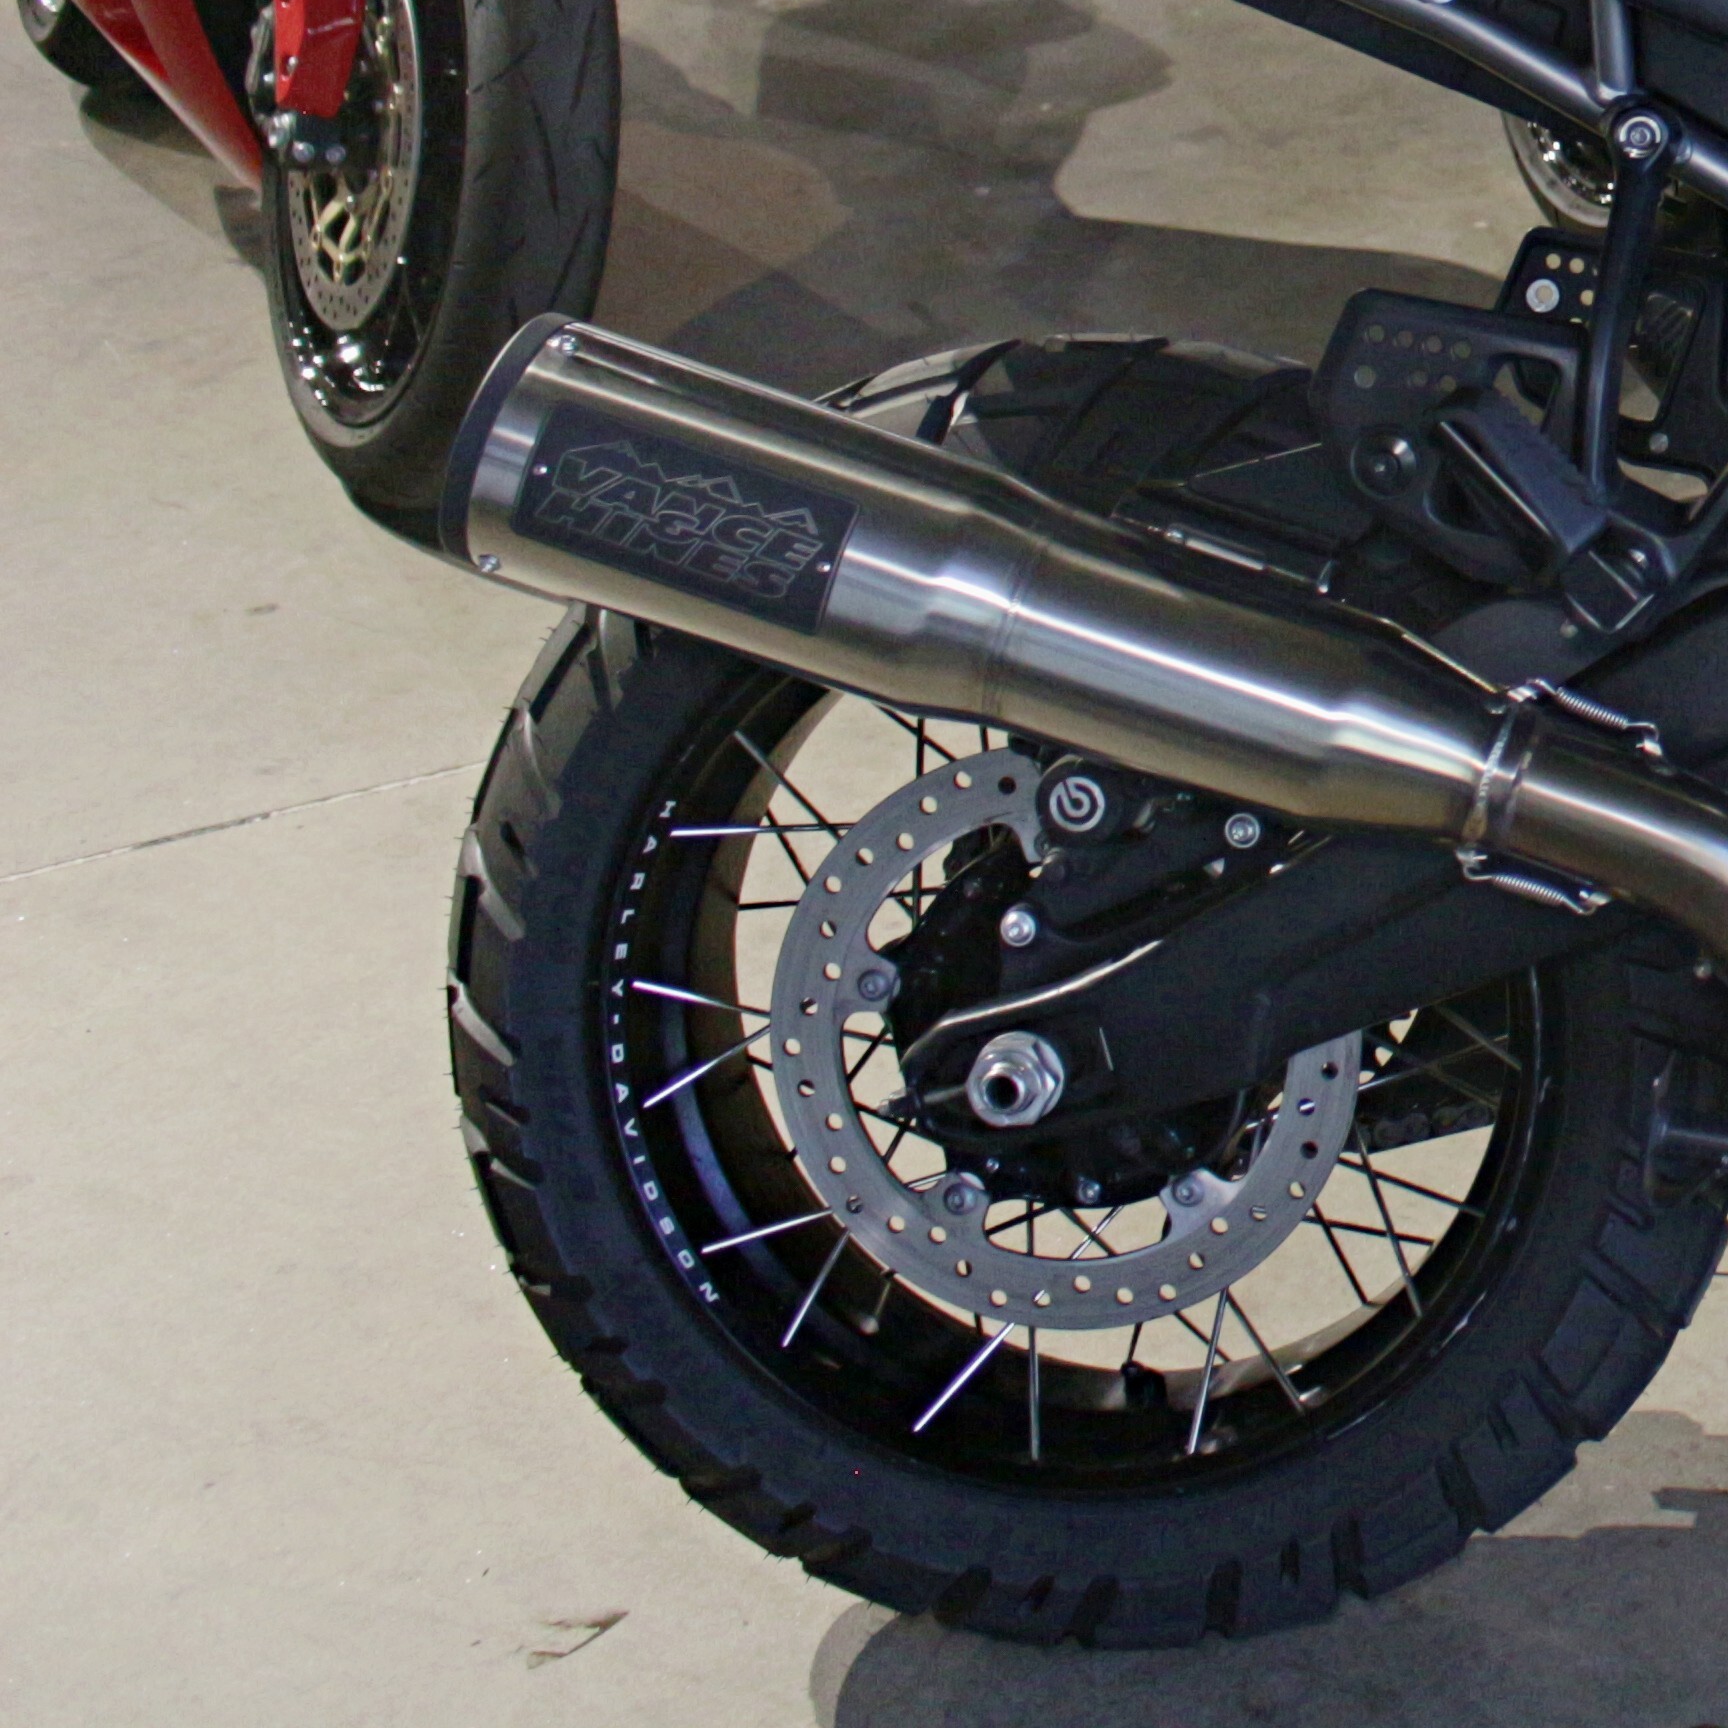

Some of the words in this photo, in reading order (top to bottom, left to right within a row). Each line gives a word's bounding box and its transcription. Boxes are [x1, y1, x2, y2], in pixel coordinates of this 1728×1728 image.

[535, 489, 796, 599] HINES
[552, 452, 824, 572] VANCE
[610, 800, 720, 1304] HARLEY-DAVIDSON
